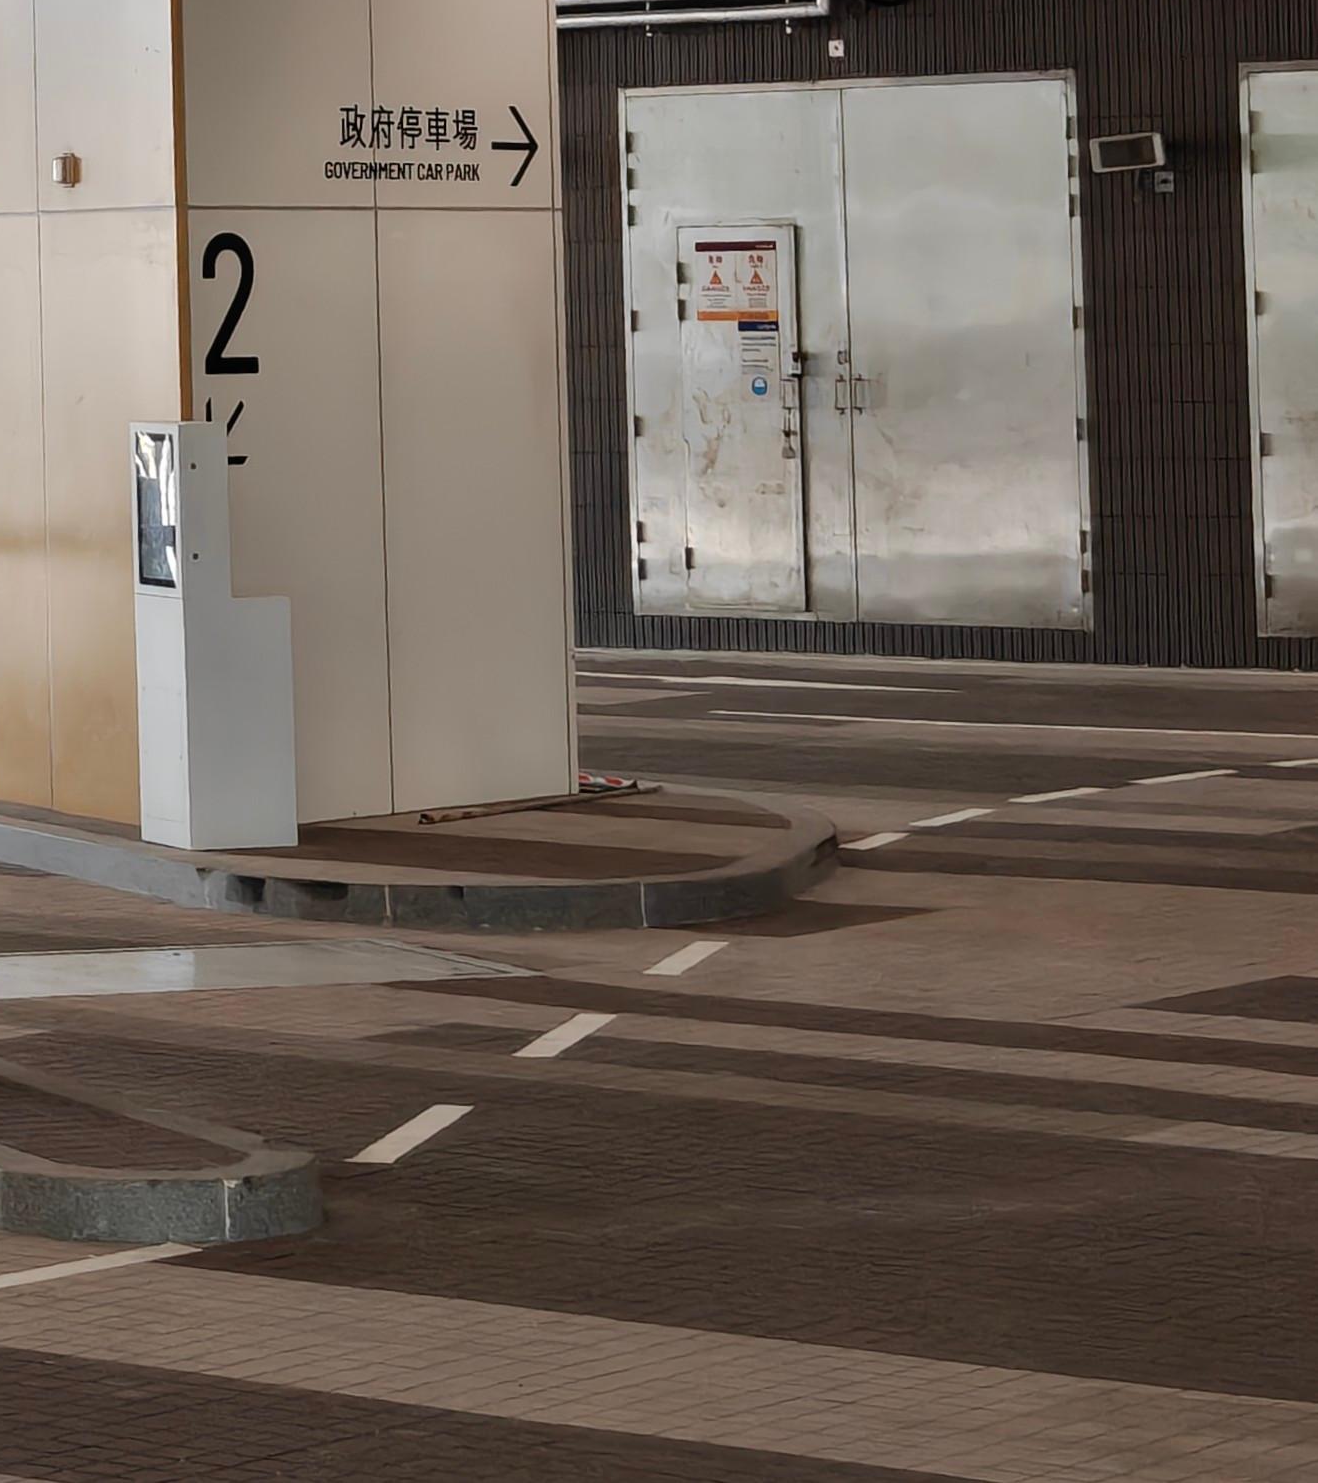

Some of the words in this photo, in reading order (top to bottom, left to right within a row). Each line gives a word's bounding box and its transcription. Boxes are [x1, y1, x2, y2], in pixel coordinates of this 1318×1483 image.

[339, 104, 478, 151] 政府停車場
[324, 161, 415, 181] GOVERNMENT
[417, 163, 443, 181] CAR
[446, 163, 480, 181] PARK
[201, 232, 260, 375] 2
